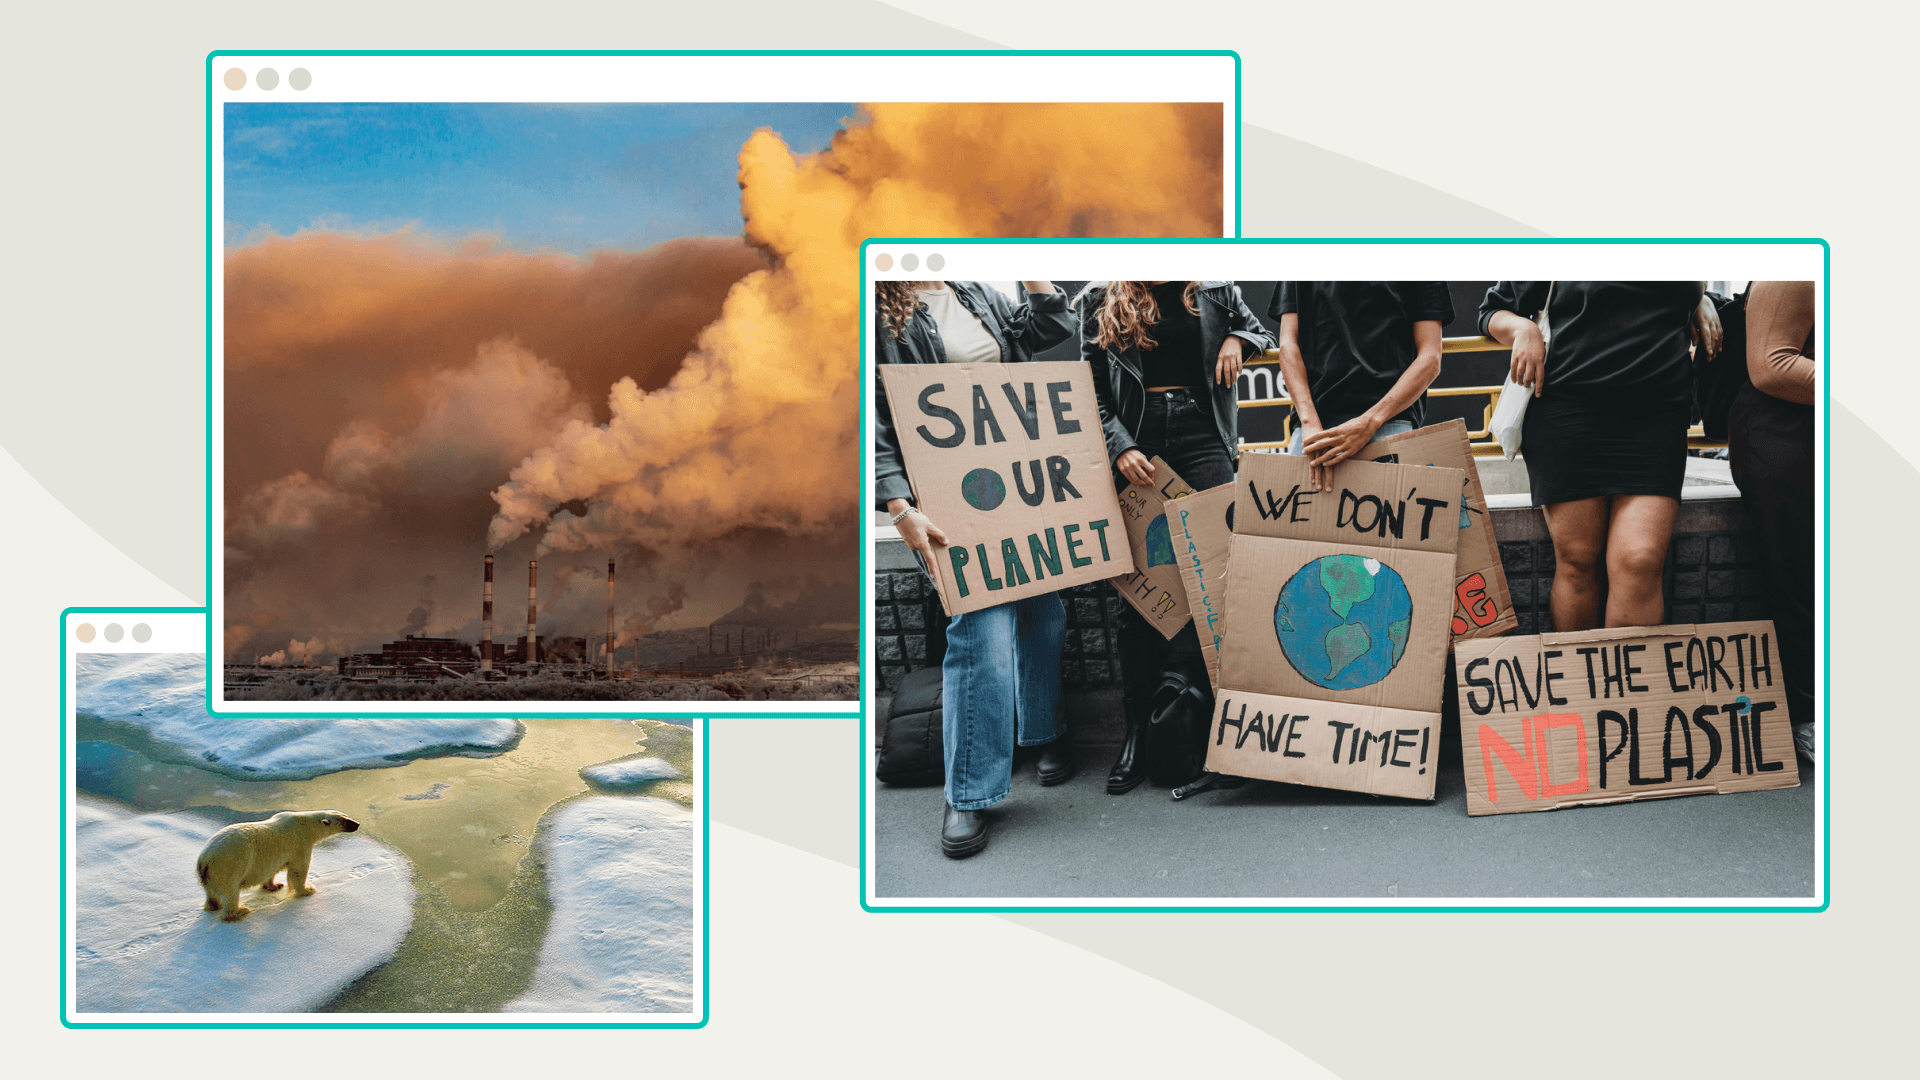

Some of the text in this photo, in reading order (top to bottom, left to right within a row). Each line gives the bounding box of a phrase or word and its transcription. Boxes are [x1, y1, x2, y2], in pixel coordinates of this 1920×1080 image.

[916, 381, 1082, 448] SAVE
[1119, 499, 1143, 520] ONLY
[1129, 491, 1147, 509] OUR
[1248, 480, 1319, 524] WE
[1336, 487, 1449, 541] DON'T
[948, 519, 1110, 598] PLANET
[1464, 633, 1773, 715] SAVE THE EARTH
[1216, 699, 1430, 776] HAVE TIME!
[1478, 712, 1590, 803] NO
